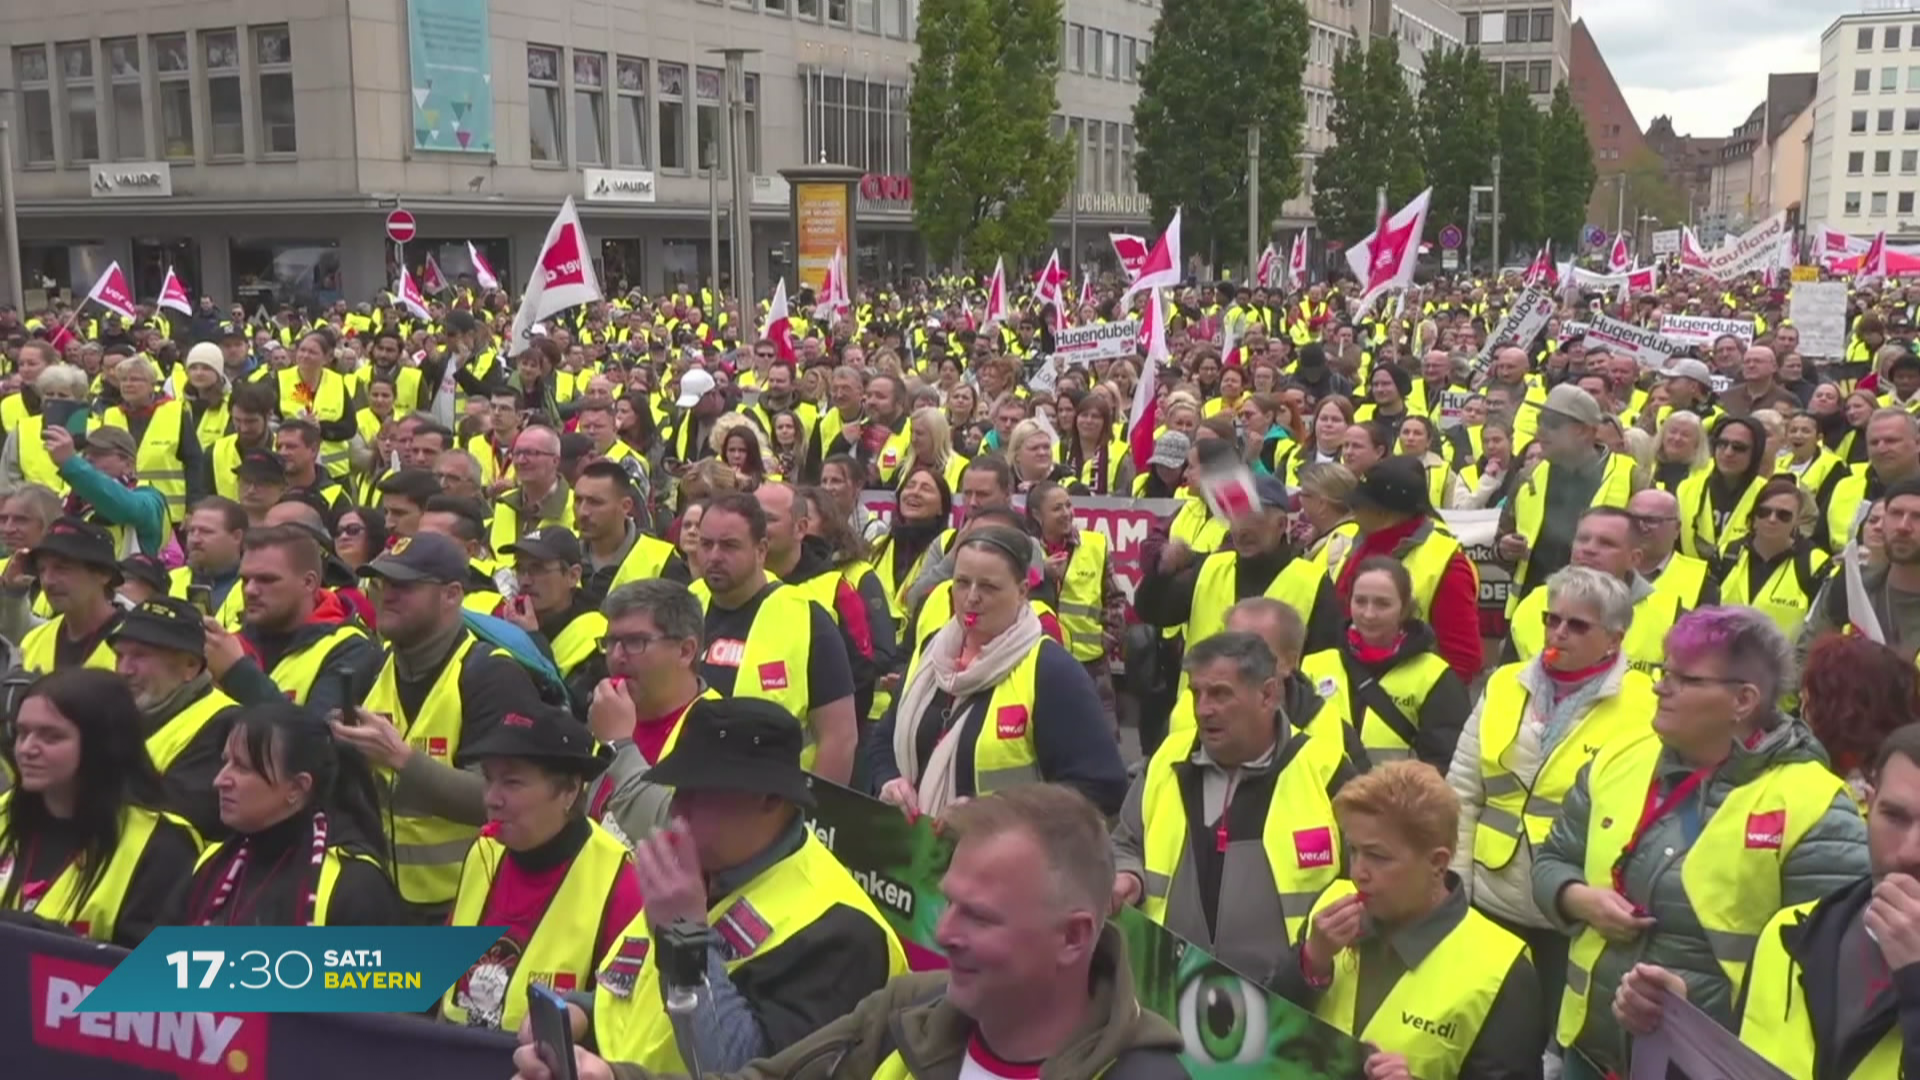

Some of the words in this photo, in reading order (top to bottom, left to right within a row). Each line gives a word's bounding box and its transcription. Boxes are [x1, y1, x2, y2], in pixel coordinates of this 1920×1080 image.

[1055, 321, 1135, 345] Hugendubel
[1590, 315, 1689, 355] Hugendubel
[1661, 315, 1753, 336] Hugendubel
[1299, 850, 1331, 862] ver.di
[1400, 1011, 1458, 1041] ver.di
